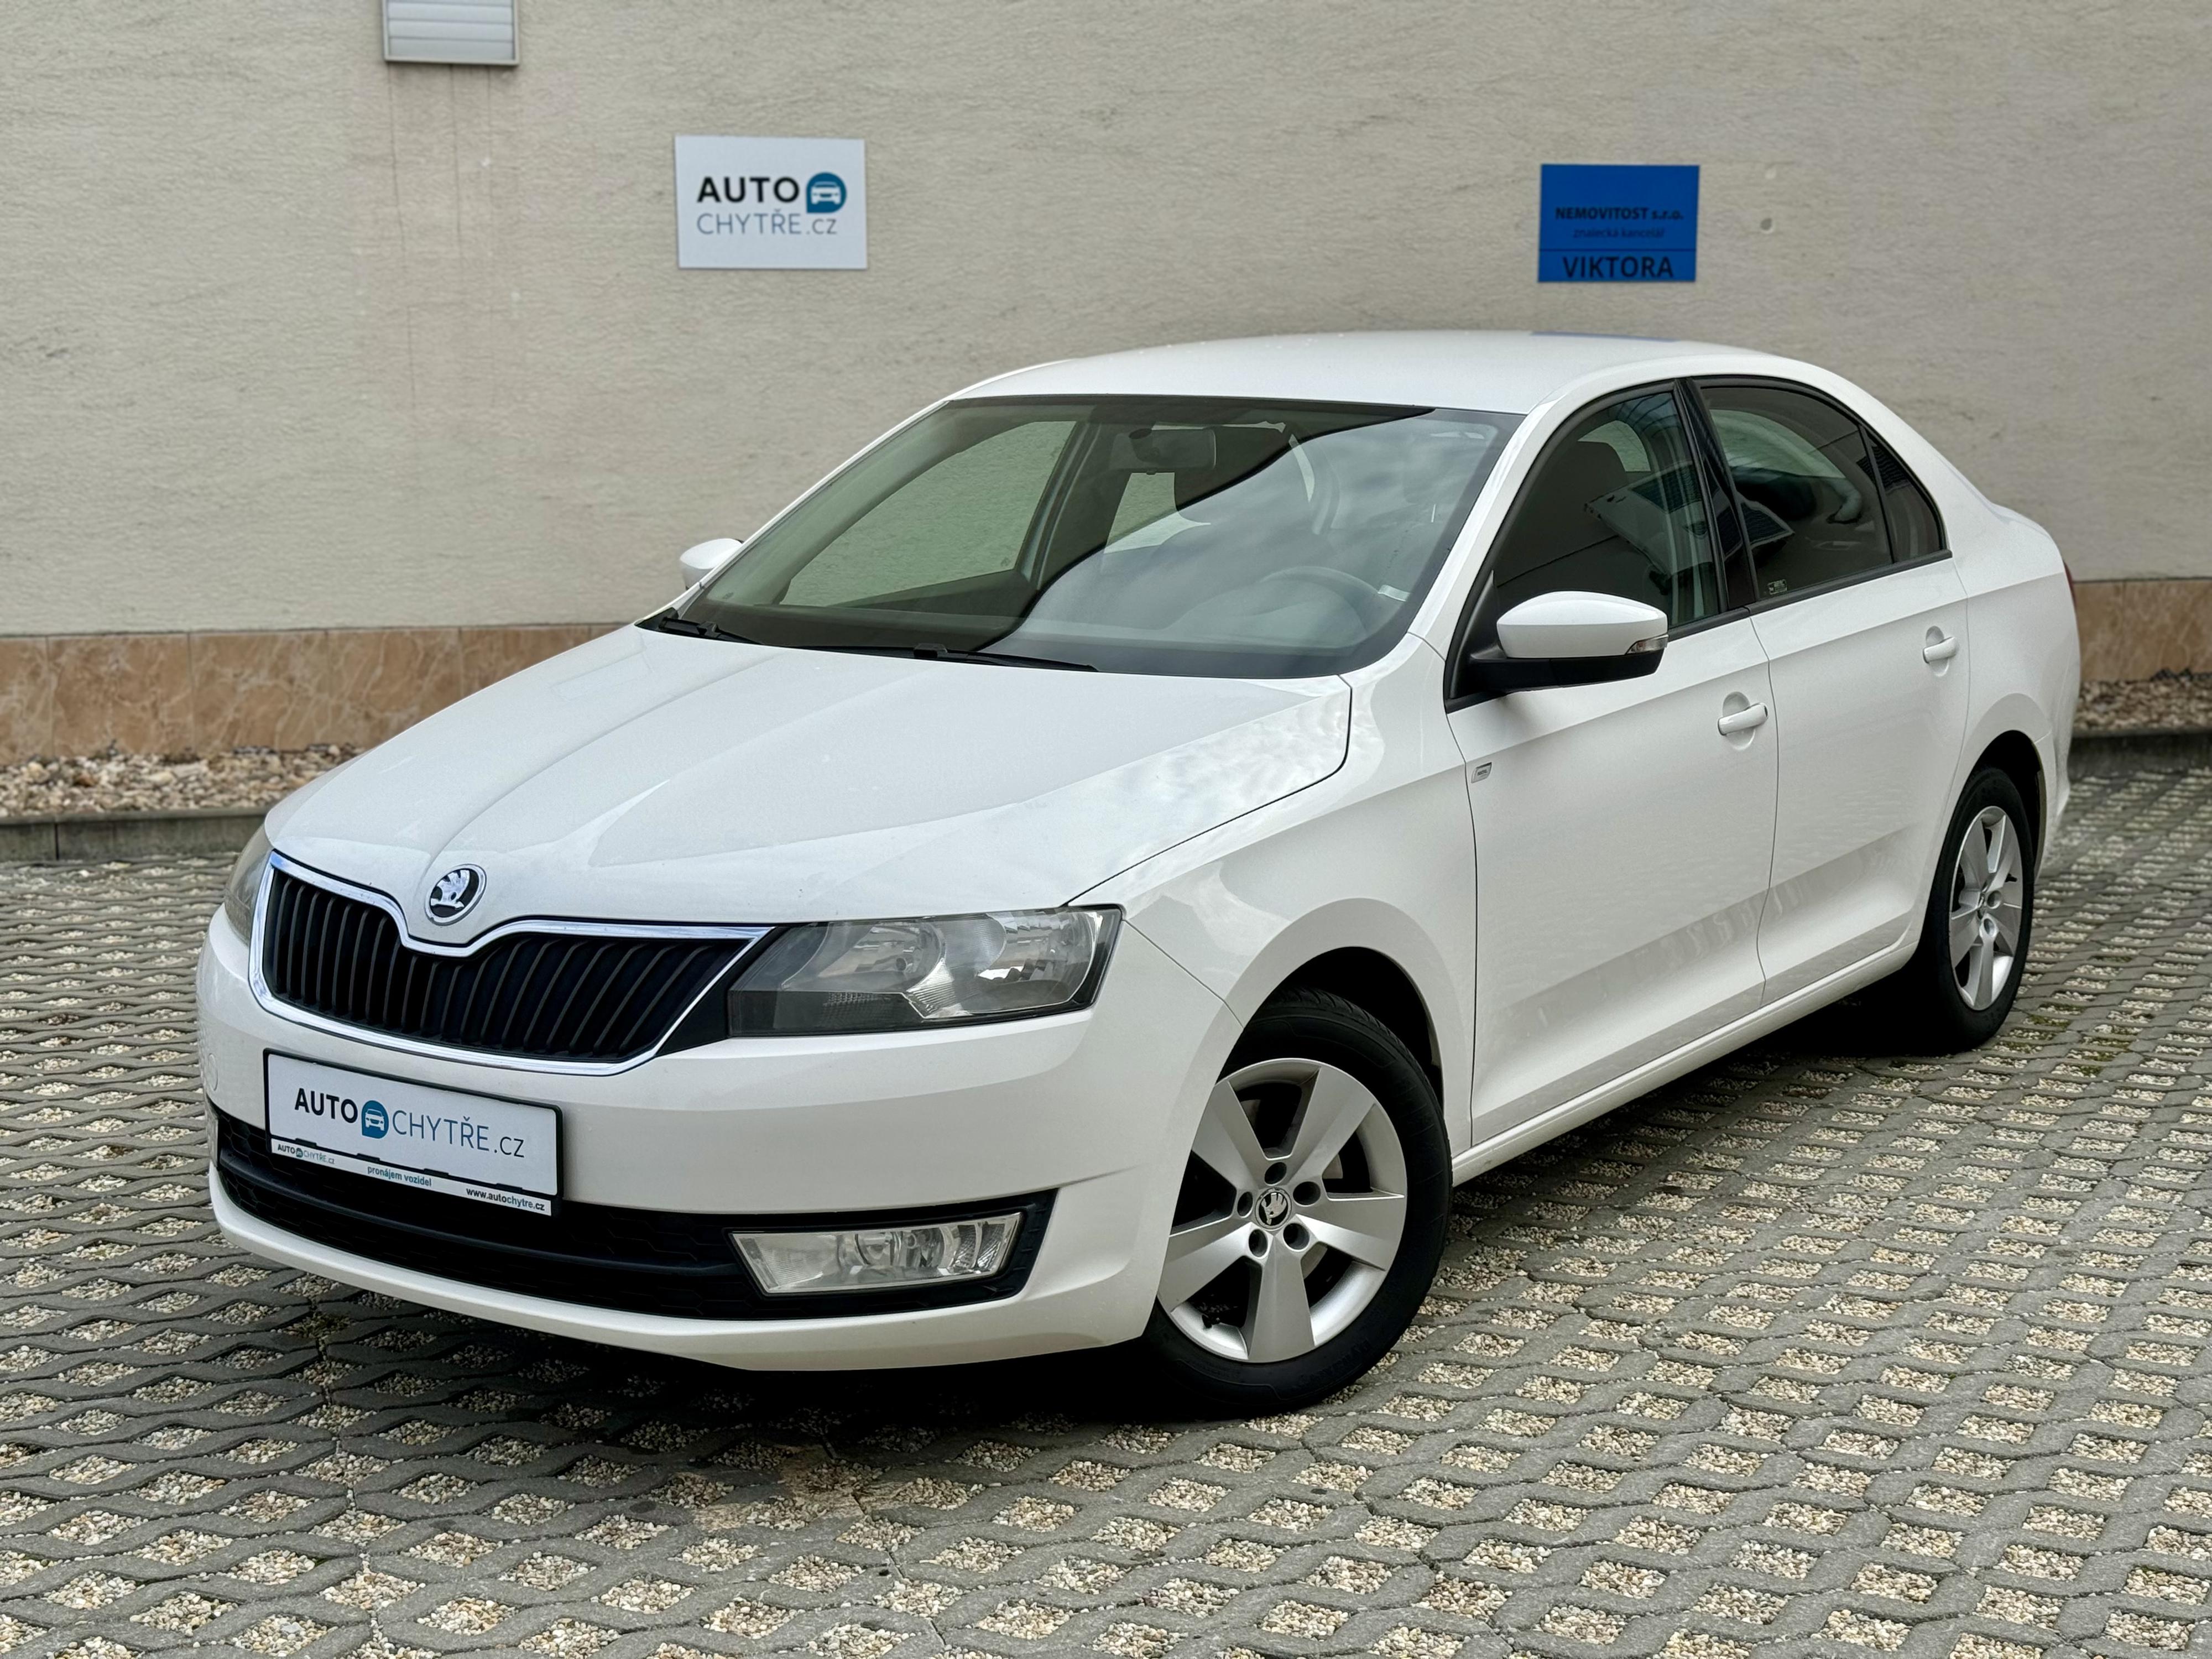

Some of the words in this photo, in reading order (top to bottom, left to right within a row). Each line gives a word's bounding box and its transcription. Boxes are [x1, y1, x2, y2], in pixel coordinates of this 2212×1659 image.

[697, 176, 800, 203] AUTO
[1555, 207, 1648, 220] NEMOVITOST
[1651, 210, 1684, 220] s.r.o.
[1562, 256, 1673, 277] VIKTORA
[295, 1087, 358, 1124] AUTO
[278, 1144, 296, 1155] AUTO
[367, 1166, 403, 1181] pronájem
[404, 1173, 432, 1187] vozidel
[466, 1188, 545, 1211] www.autochytre.cz
